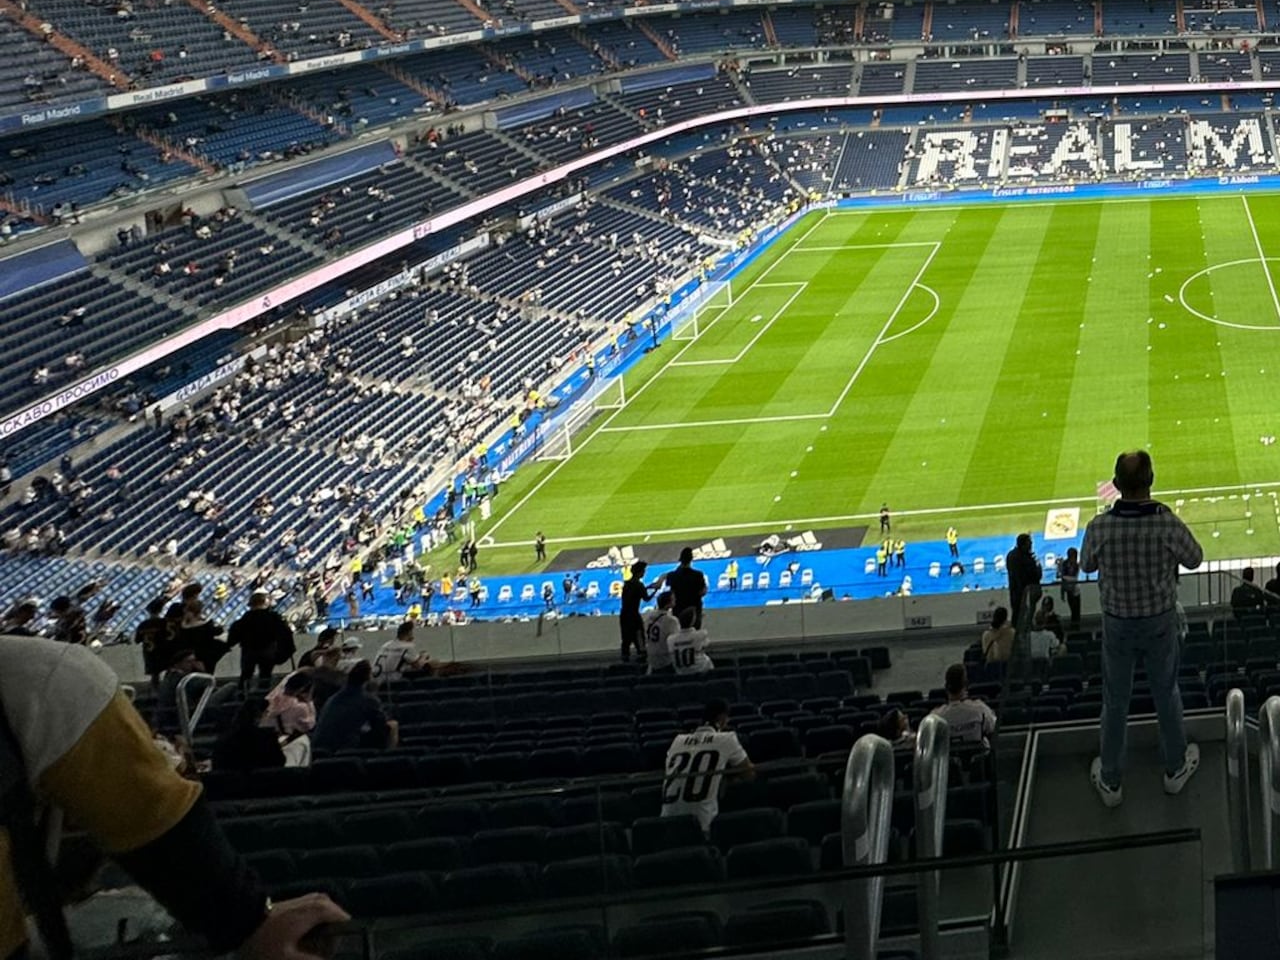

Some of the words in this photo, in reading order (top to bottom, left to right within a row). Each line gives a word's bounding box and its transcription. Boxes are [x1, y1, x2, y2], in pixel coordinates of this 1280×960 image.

[133, 91, 153, 103] Real
[155, 86, 185, 100] Madrid
[22, 111, 45, 125] Real
[49, 105, 81, 121] Madrid
[916, 122, 1164, 181] REAL
[56, 368, 119, 407] ПРОСИМО
[674, 647, 695, 668] 10
[663, 750, 720, 804] 20
